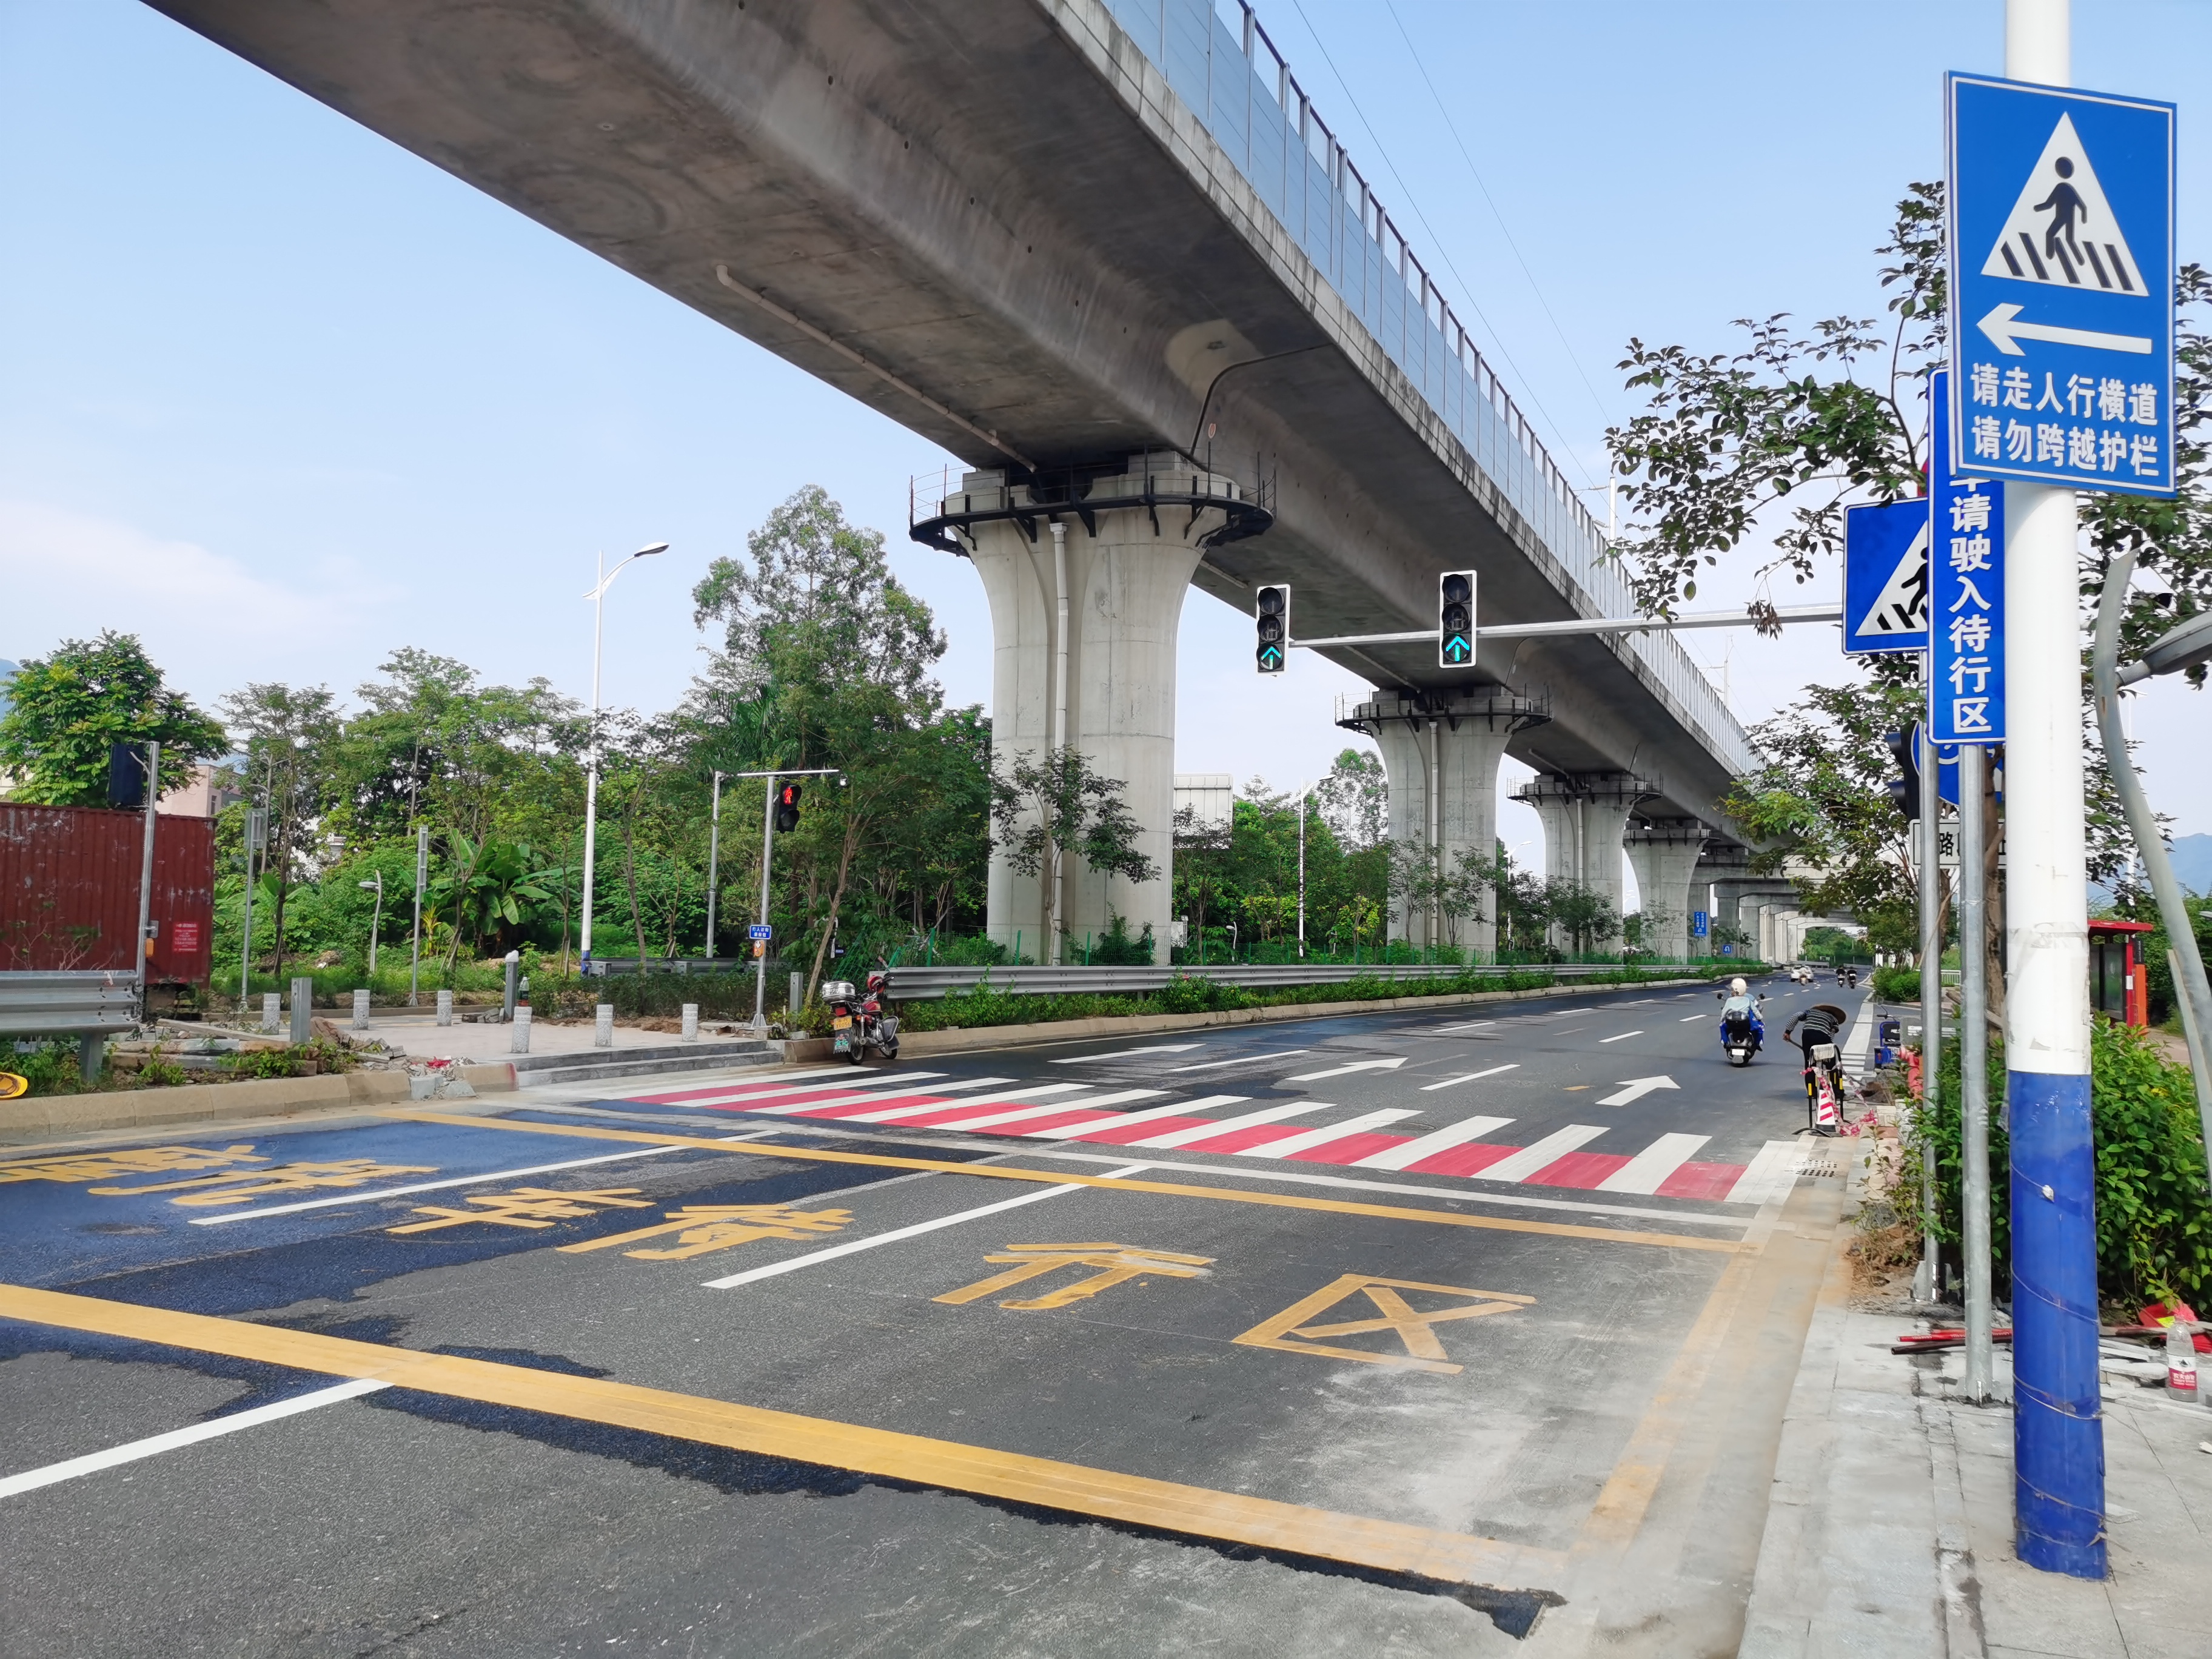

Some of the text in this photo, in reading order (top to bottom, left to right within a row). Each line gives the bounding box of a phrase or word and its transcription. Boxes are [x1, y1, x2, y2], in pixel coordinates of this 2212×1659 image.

[1971, 362, 2158, 426] 请走人行横道
[1972, 415, 2159, 477] 请勿跨越护栏
